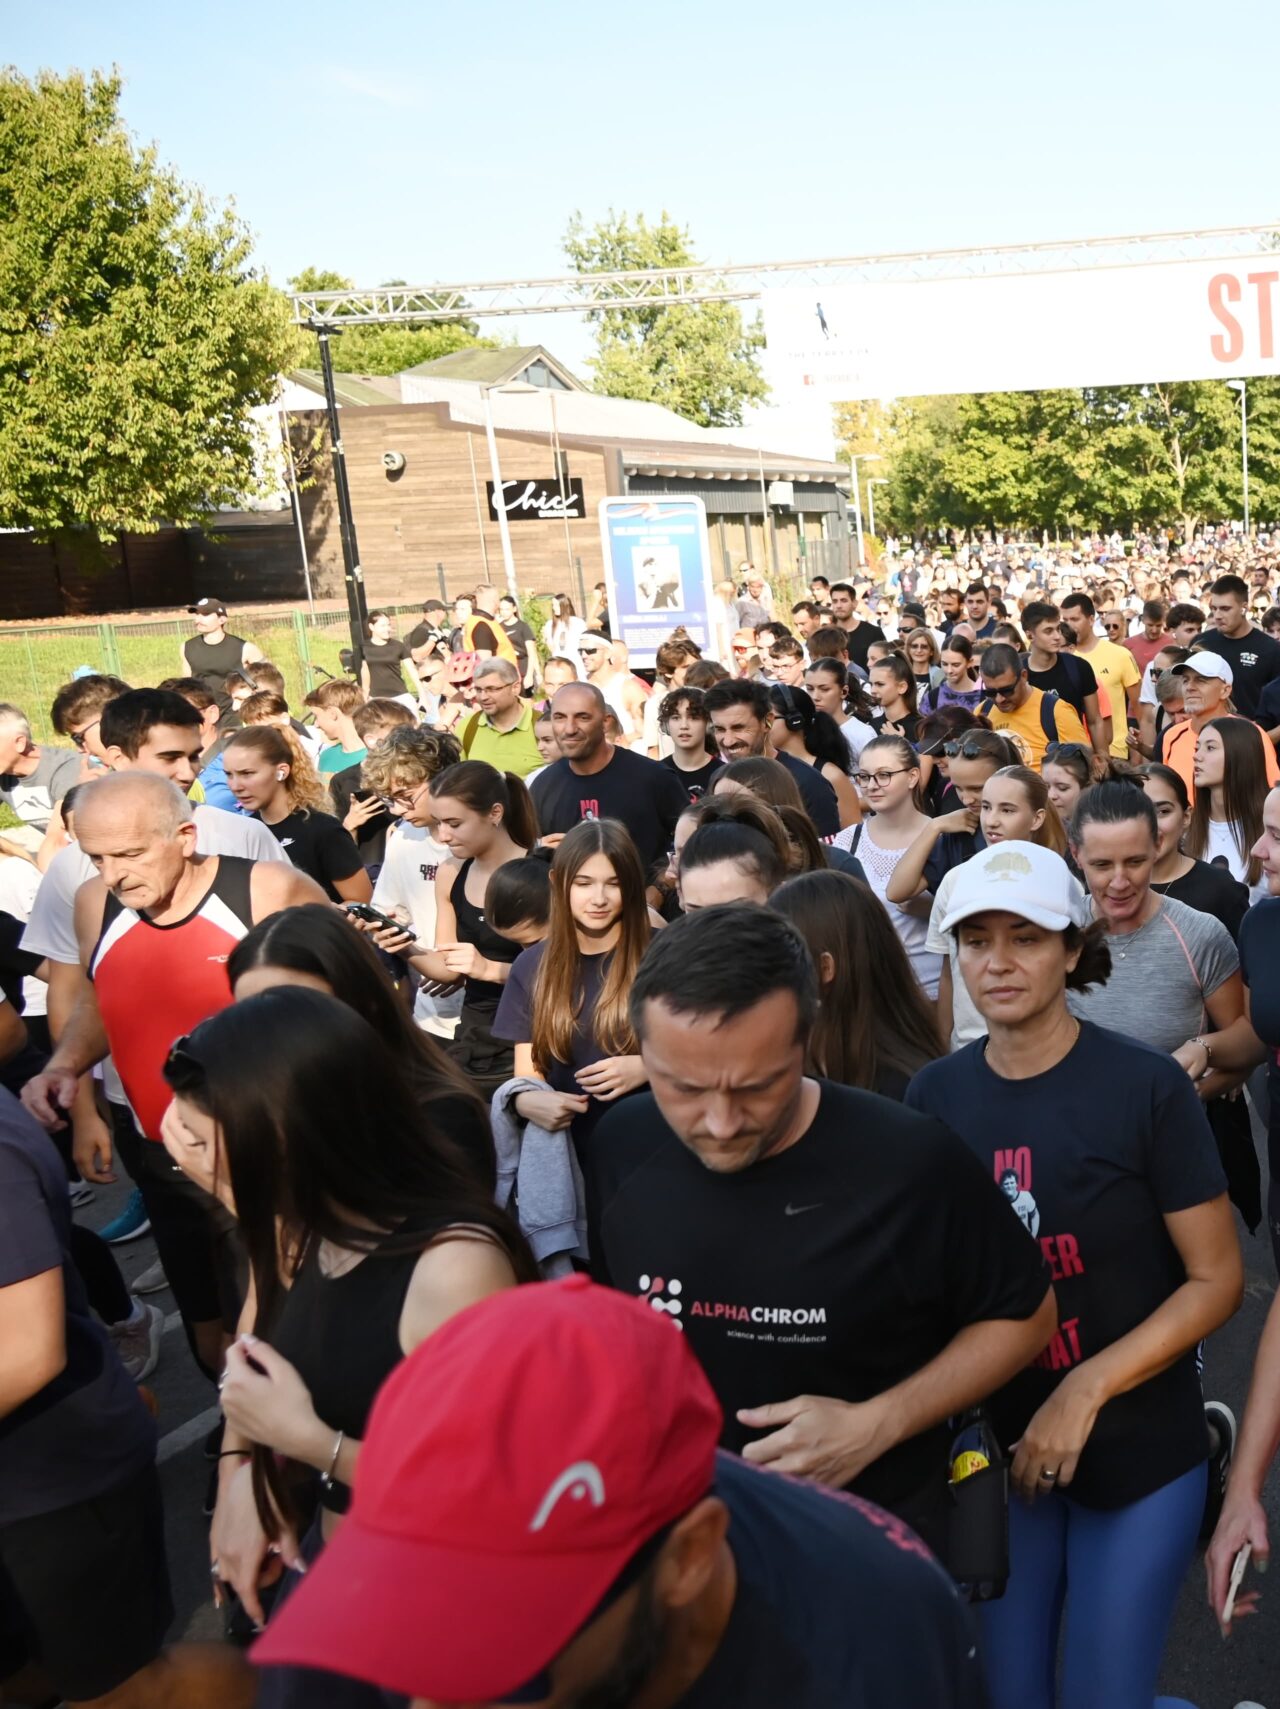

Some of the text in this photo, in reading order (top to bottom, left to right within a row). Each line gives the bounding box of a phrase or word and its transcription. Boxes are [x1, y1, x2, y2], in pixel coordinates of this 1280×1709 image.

[491, 480, 578, 512] Chic
[580, 798, 599, 819] NO
[993, 1146, 1032, 1192] NO
[690, 1300, 827, 1325] ALPHACHROM
[727, 1328, 827, 1344] science with confidence
